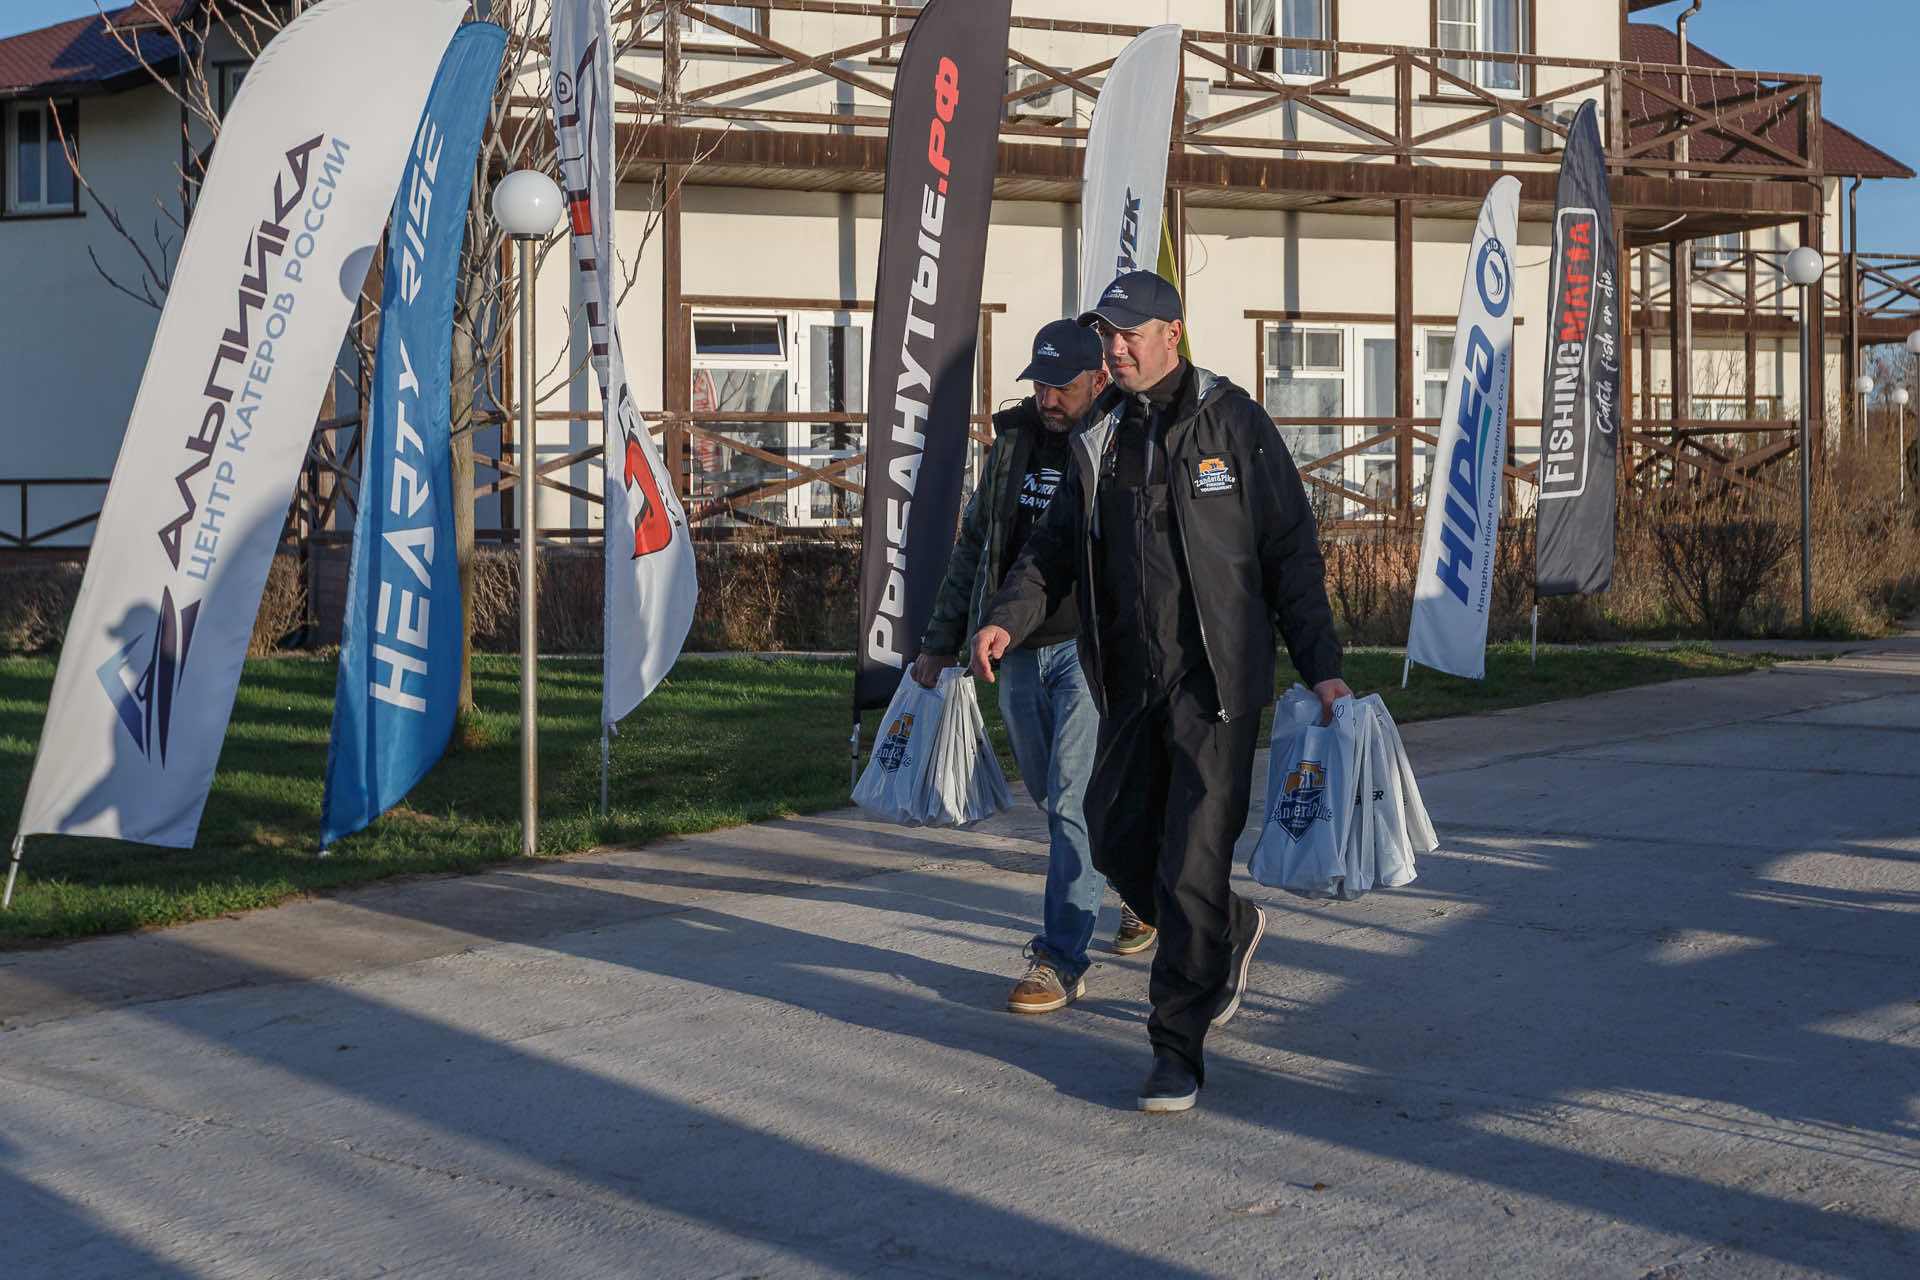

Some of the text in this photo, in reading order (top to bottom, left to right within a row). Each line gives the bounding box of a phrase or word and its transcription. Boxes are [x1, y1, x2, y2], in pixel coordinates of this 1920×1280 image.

[158, 132, 325, 572] АЛЬПИЙКА
[186, 137, 351, 582] ЦЕНТР КАТЕРОВ РОССИИ
[368, 112, 445, 713] HEARTY RISE
[867, 56, 960, 669] РЫБАНУТЫЕ.РФ
[1594, 269, 1618, 434] Catch fish or die
[1487, 471, 1497, 508] Power
[1491, 403, 1504, 467] Machinery
[1476, 551, 1491, 614] Hangzhou
[1484, 512, 1493, 547] Hidea
